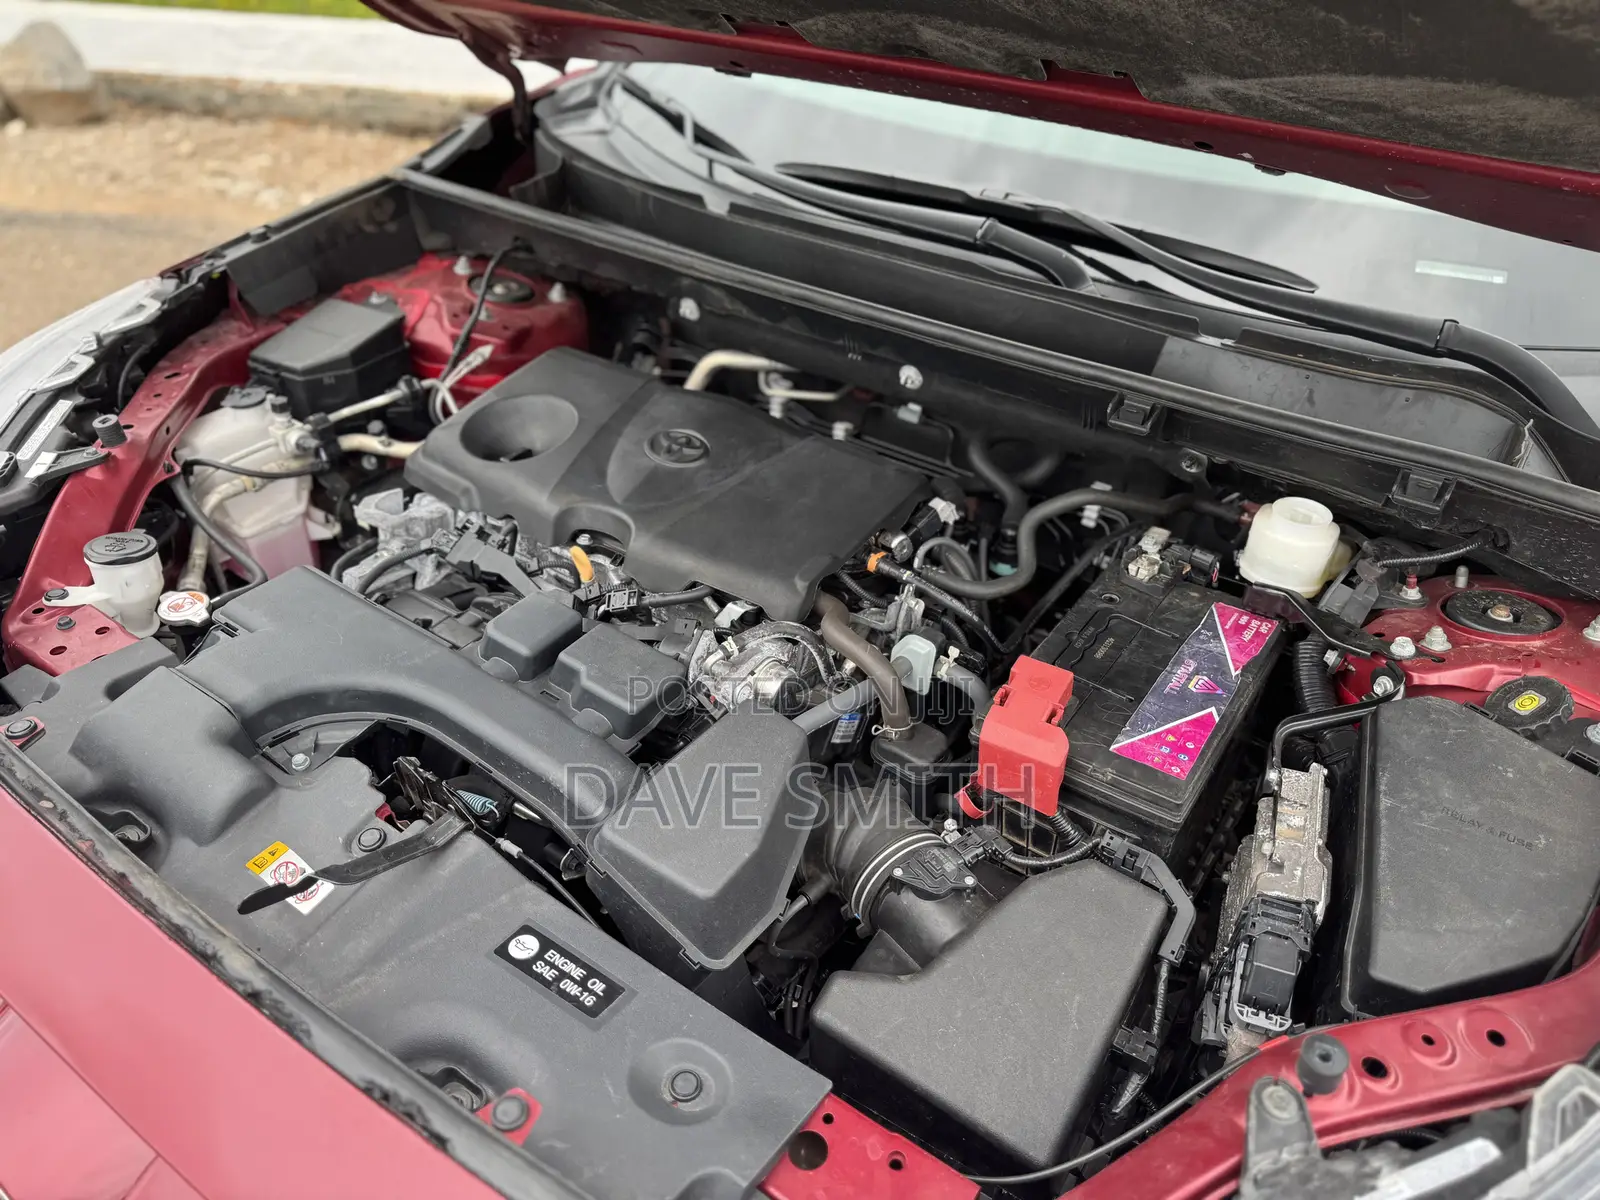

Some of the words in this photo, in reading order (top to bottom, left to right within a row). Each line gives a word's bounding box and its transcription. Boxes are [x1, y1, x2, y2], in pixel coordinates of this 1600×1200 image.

[1241, 619, 1261, 643] BATTERY
[1258, 621, 1272, 634] CAR
[1440, 806, 1483, 829] RELAY
[1499, 830, 1534, 851] FUSE
[532, 960, 559, 981] SAE
[559, 979, 597, 1007] 0W-16
[543, 949, 587, 981] ENGINE
[587, 978, 607, 996] OIL
